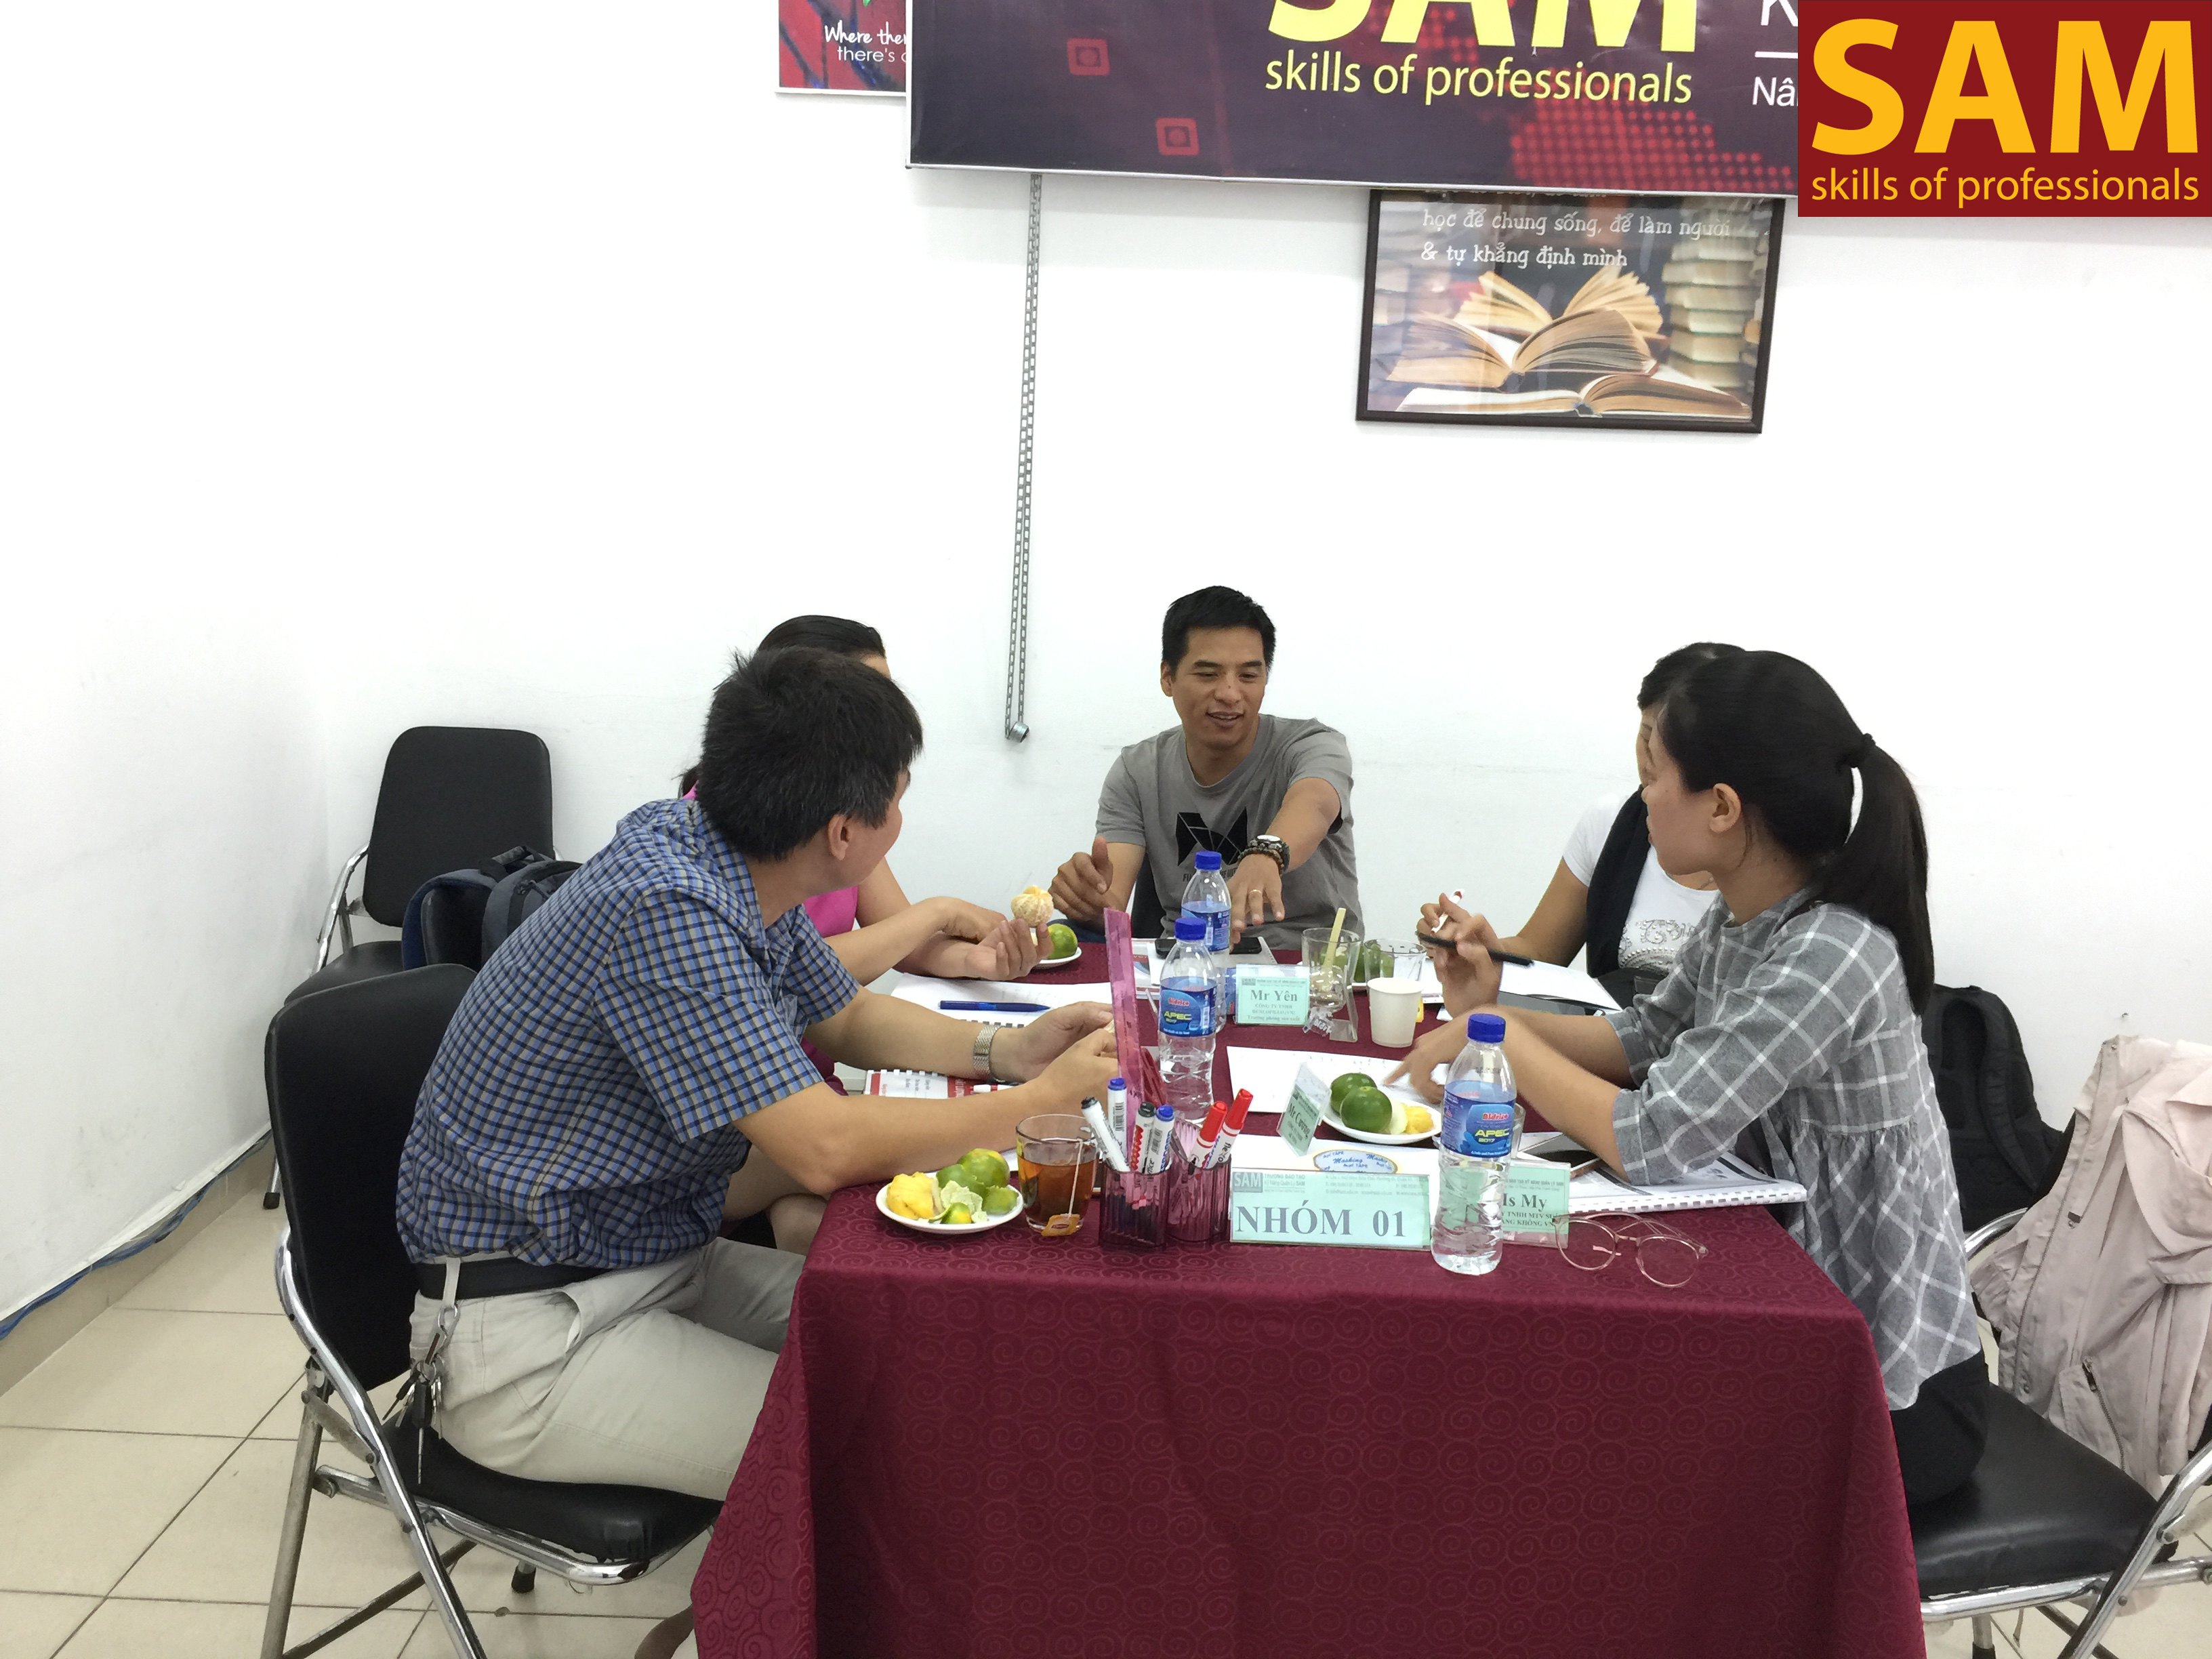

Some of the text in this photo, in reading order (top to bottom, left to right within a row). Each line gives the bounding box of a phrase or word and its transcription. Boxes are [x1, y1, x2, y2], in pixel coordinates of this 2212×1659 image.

[824, 20, 873, 43] Where
[837, 45, 895, 62] there's
[1265, 49, 1692, 106] skills of professionals
[1422, 208, 1731, 241] học để chung sống, để làm người
[1473, 242, 1530, 269] khẳng
[1536, 245, 1576, 270] định
[1582, 248, 1628, 266] mình
[1250, 989, 1298, 1002] Mr Yên
[1164, 1010, 1192, 1021] APEC
[1475, 1128, 1510, 1138] APEC
[1234, 1172, 1261, 1187] SAM
[1521, 1194, 1547, 1212] My
[1235, 1200, 1406, 1237] NHÓM 01
